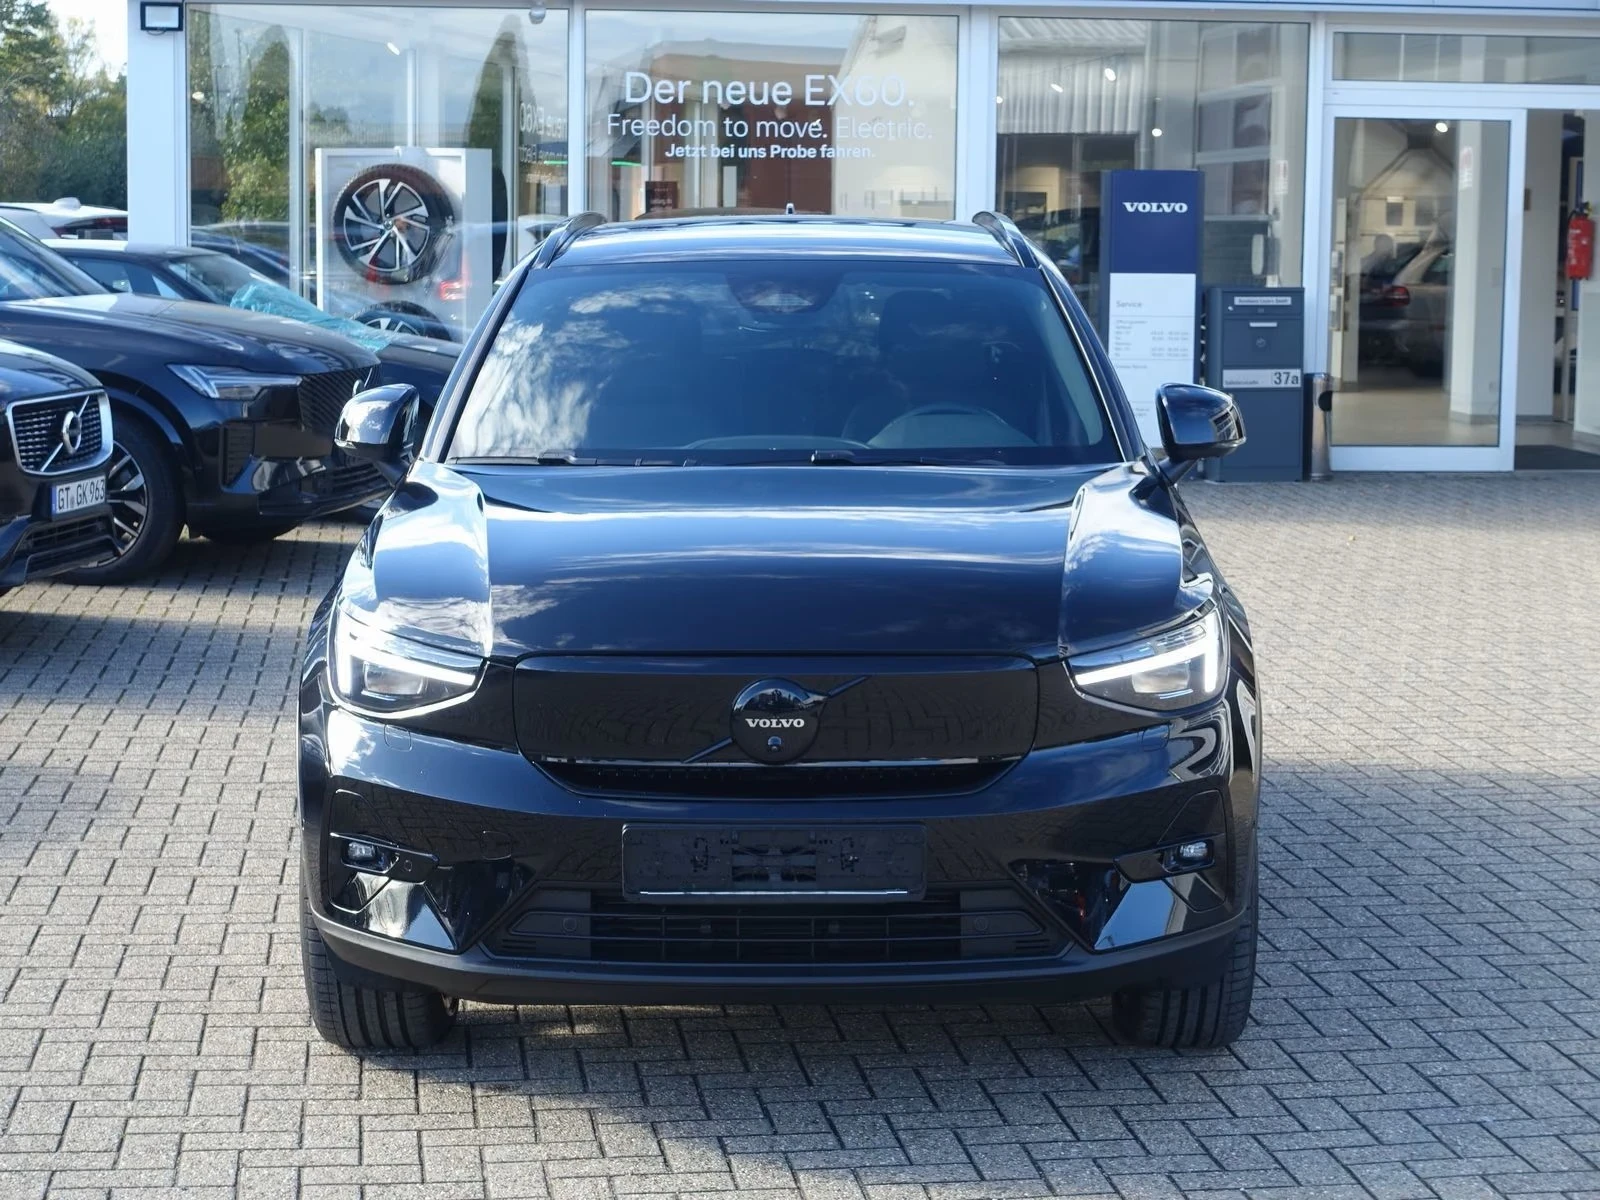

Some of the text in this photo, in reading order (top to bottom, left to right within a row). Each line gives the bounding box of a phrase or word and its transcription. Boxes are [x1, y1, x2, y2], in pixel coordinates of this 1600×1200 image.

[625, 71, 915, 107] Der neue EX60.
[607, 113, 716, 137] Freedom
[723, 116, 749, 138] to
[836, 116, 933, 140] Electric.
[665, 143, 875, 159] Jetzt bei uns Probe fahren.
[1122, 202, 1188, 213] VOLVO
[1274, 371, 1299, 385] 37a
[58, 479, 105, 510] GT GK 963
[745, 718, 805, 728] VOLVO
